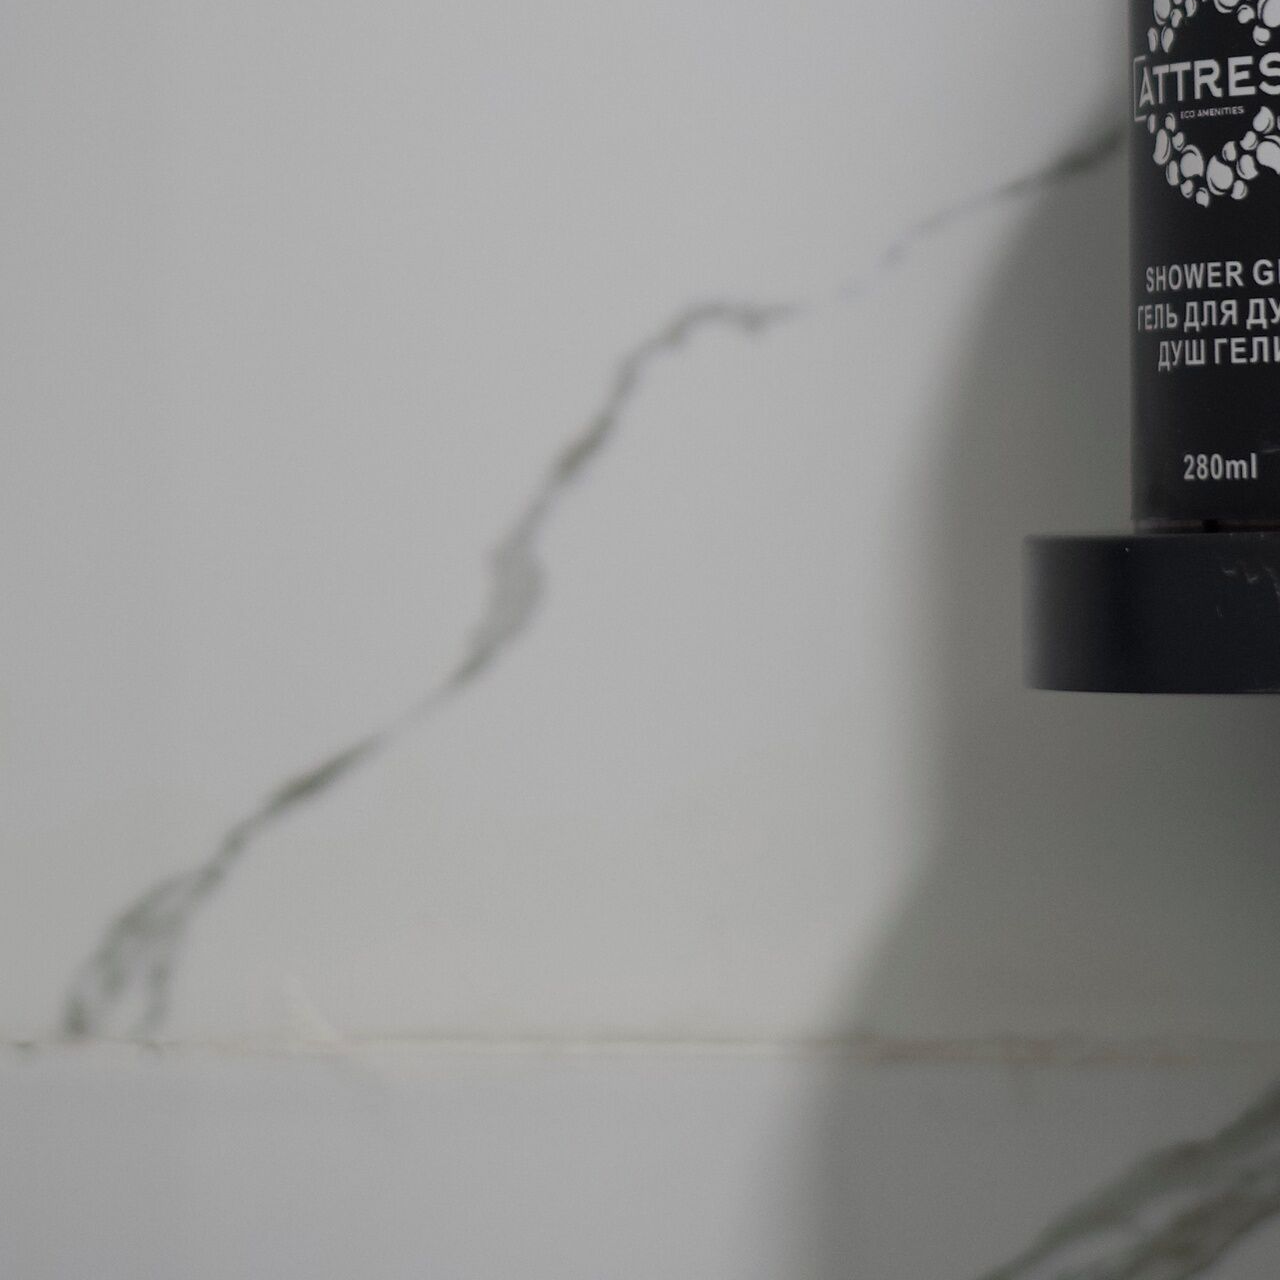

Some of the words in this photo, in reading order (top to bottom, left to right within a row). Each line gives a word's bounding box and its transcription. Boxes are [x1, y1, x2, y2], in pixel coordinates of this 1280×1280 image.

[1197, 105, 1245, 118] AMENITIES
[1146, 261, 1245, 293] SHOWER
[1137, 303, 1178, 331] ГЕЛЬ
[1183, 300, 1238, 332] ДЛЯ
[1158, 338, 1207, 372] ДУШ
[1183, 452, 1258, 481] 280ml
